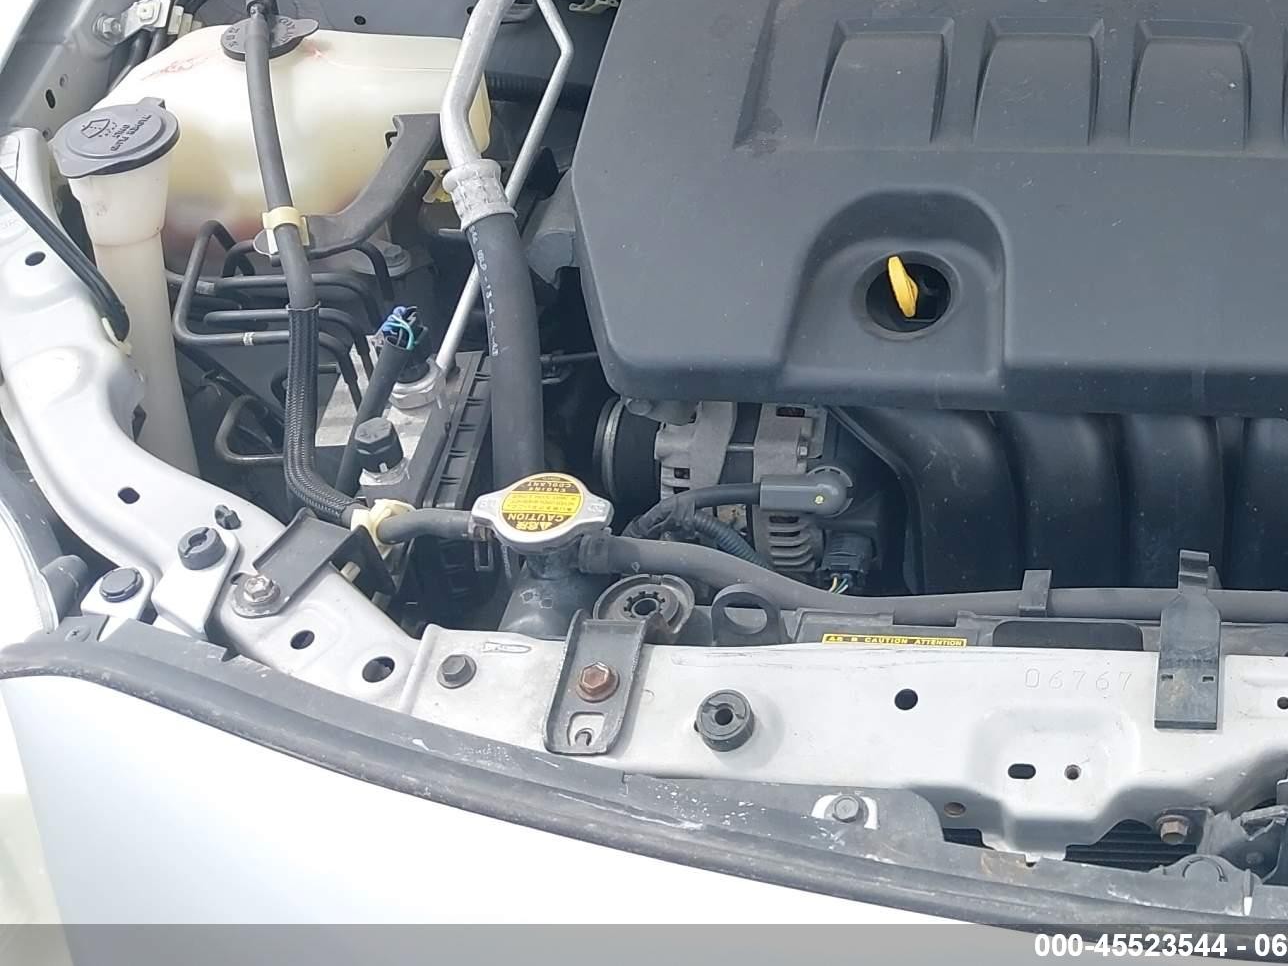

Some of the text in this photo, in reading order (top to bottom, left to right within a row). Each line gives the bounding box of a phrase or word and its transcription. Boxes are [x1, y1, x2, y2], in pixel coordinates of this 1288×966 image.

[507, 513, 564, 522] CAUTION
[864, 636, 909, 644] CAUTION
[914, 638, 962, 647] ATTENTION
[1024, 667, 1133, 690] 06767
